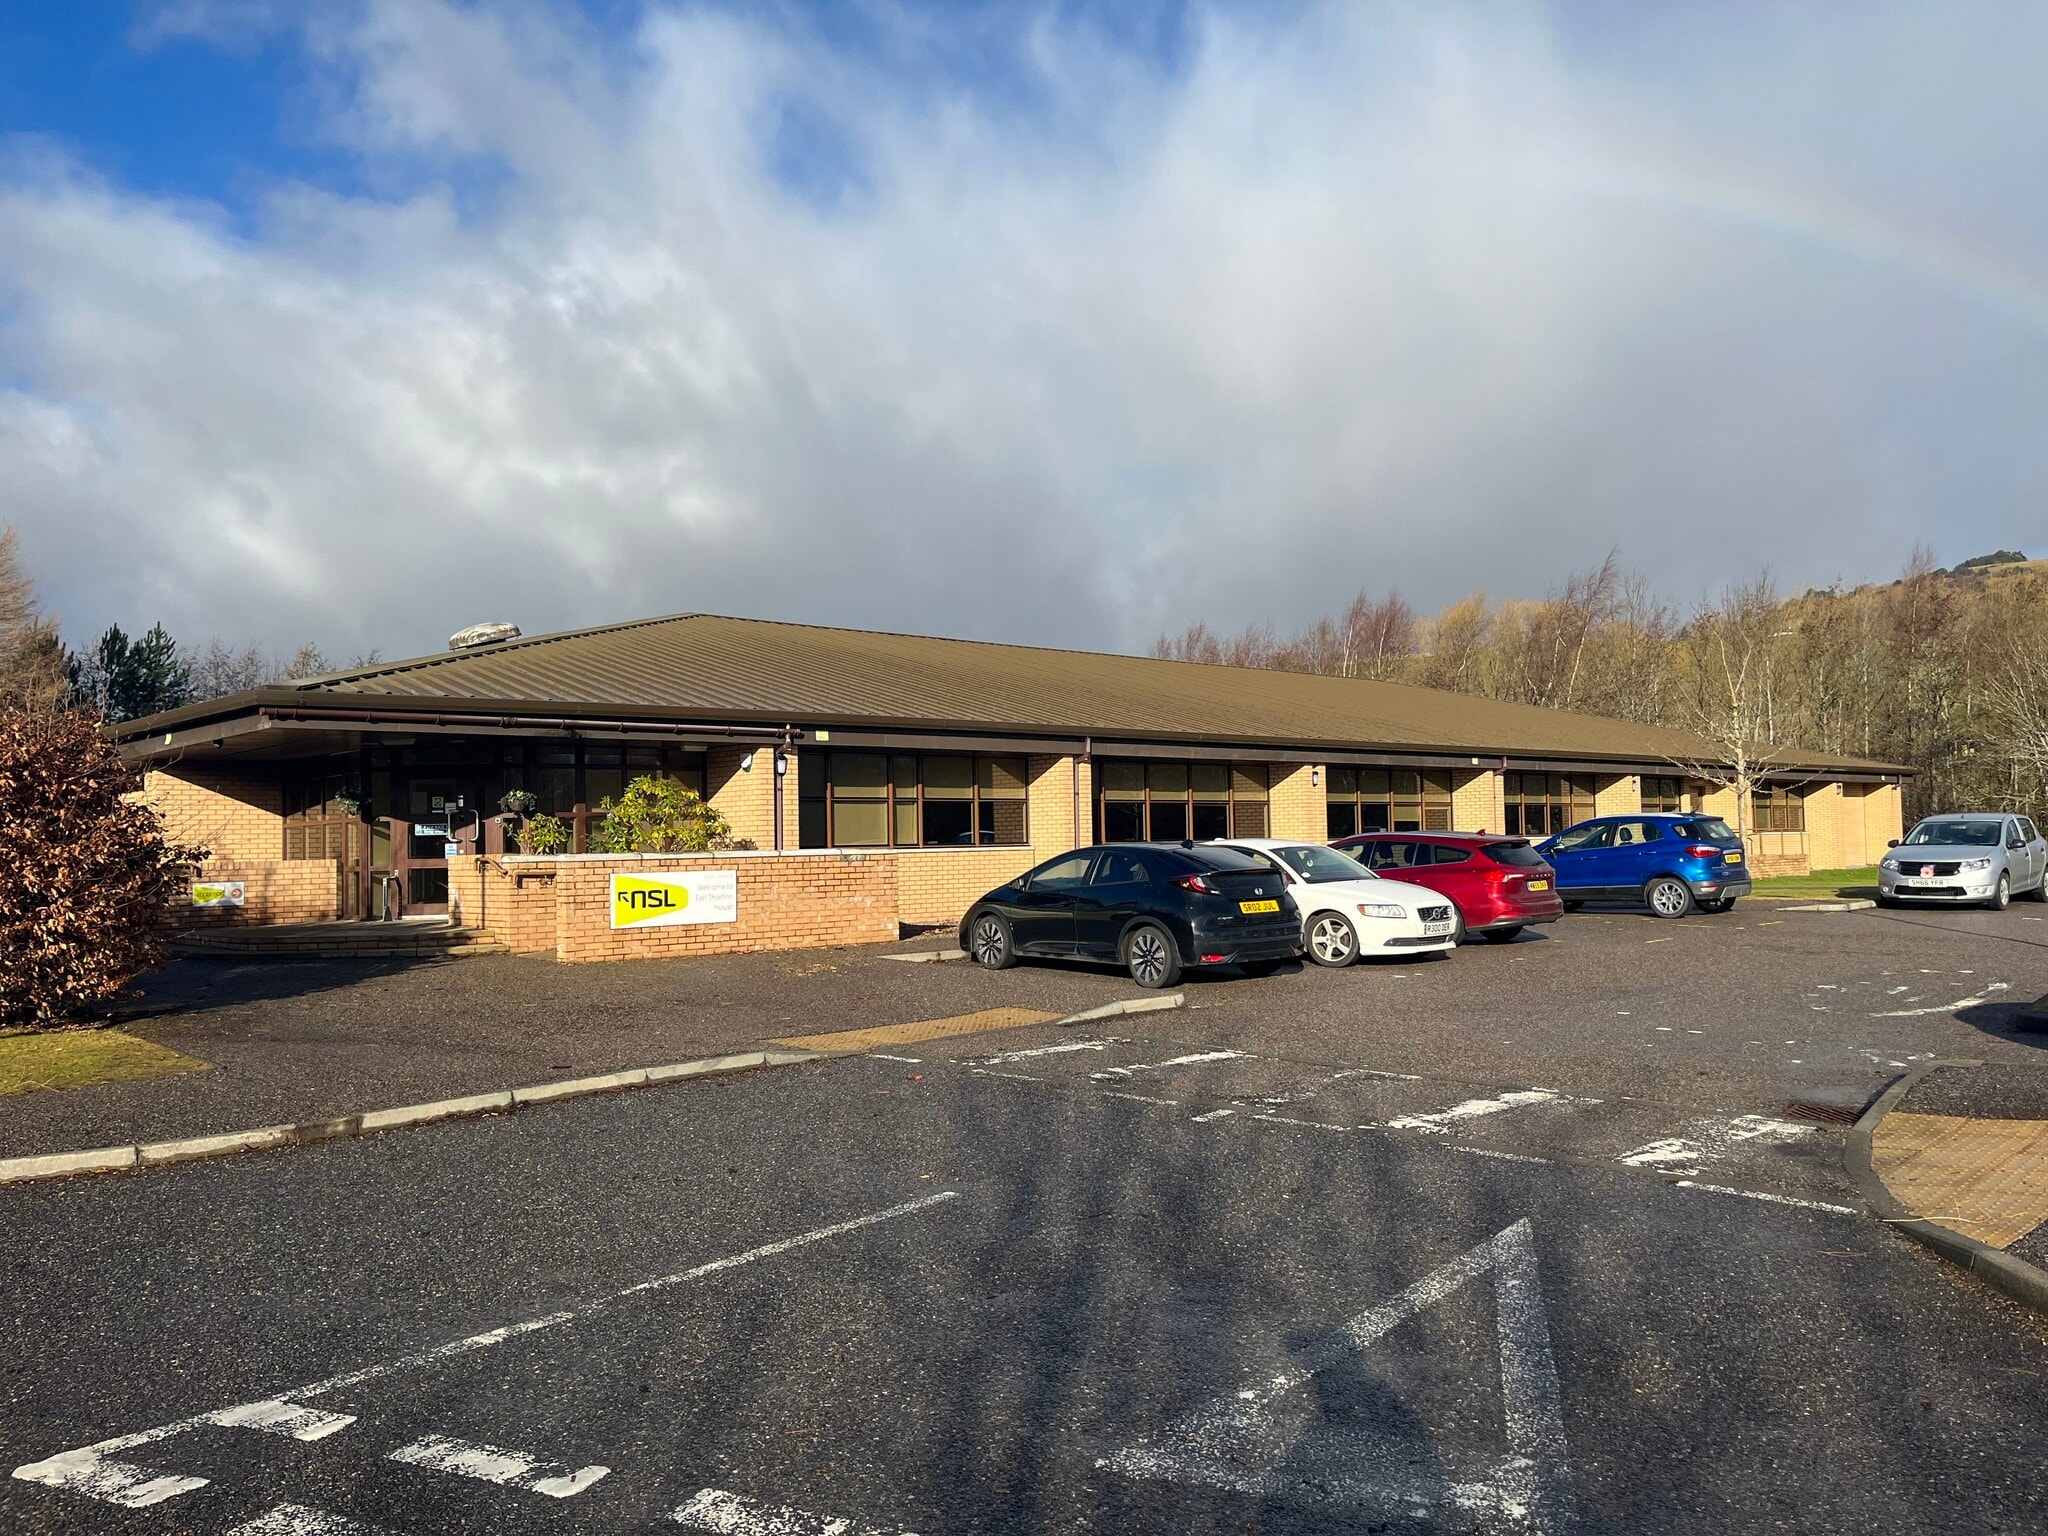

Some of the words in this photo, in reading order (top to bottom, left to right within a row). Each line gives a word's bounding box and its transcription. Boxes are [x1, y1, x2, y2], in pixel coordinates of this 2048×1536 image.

[696, 883, 726, 891] Welcome
[695, 893, 707, 902] Earl
[714, 903, 734, 911] House
